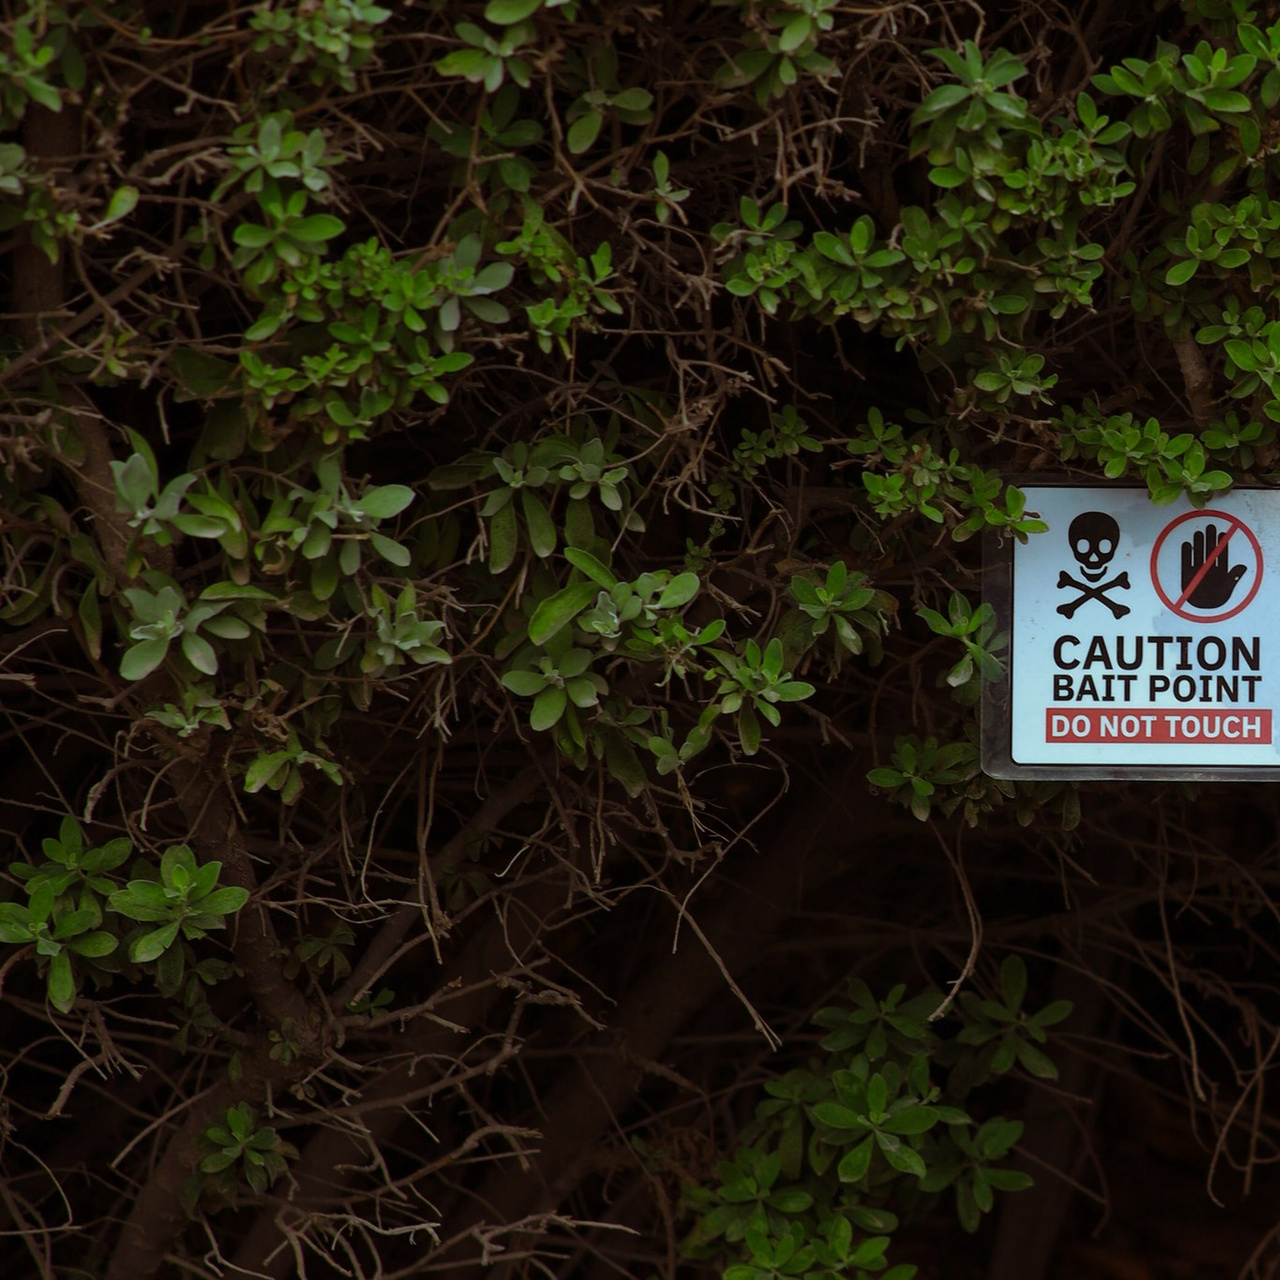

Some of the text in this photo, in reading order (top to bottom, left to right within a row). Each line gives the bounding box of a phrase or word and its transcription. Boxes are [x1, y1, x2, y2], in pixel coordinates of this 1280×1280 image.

[1053, 635, 1260, 671] CAUTION
[1053, 675, 1262, 702] BAIT POINT
[1052, 715, 1260, 738] DO NOT TOUCH
